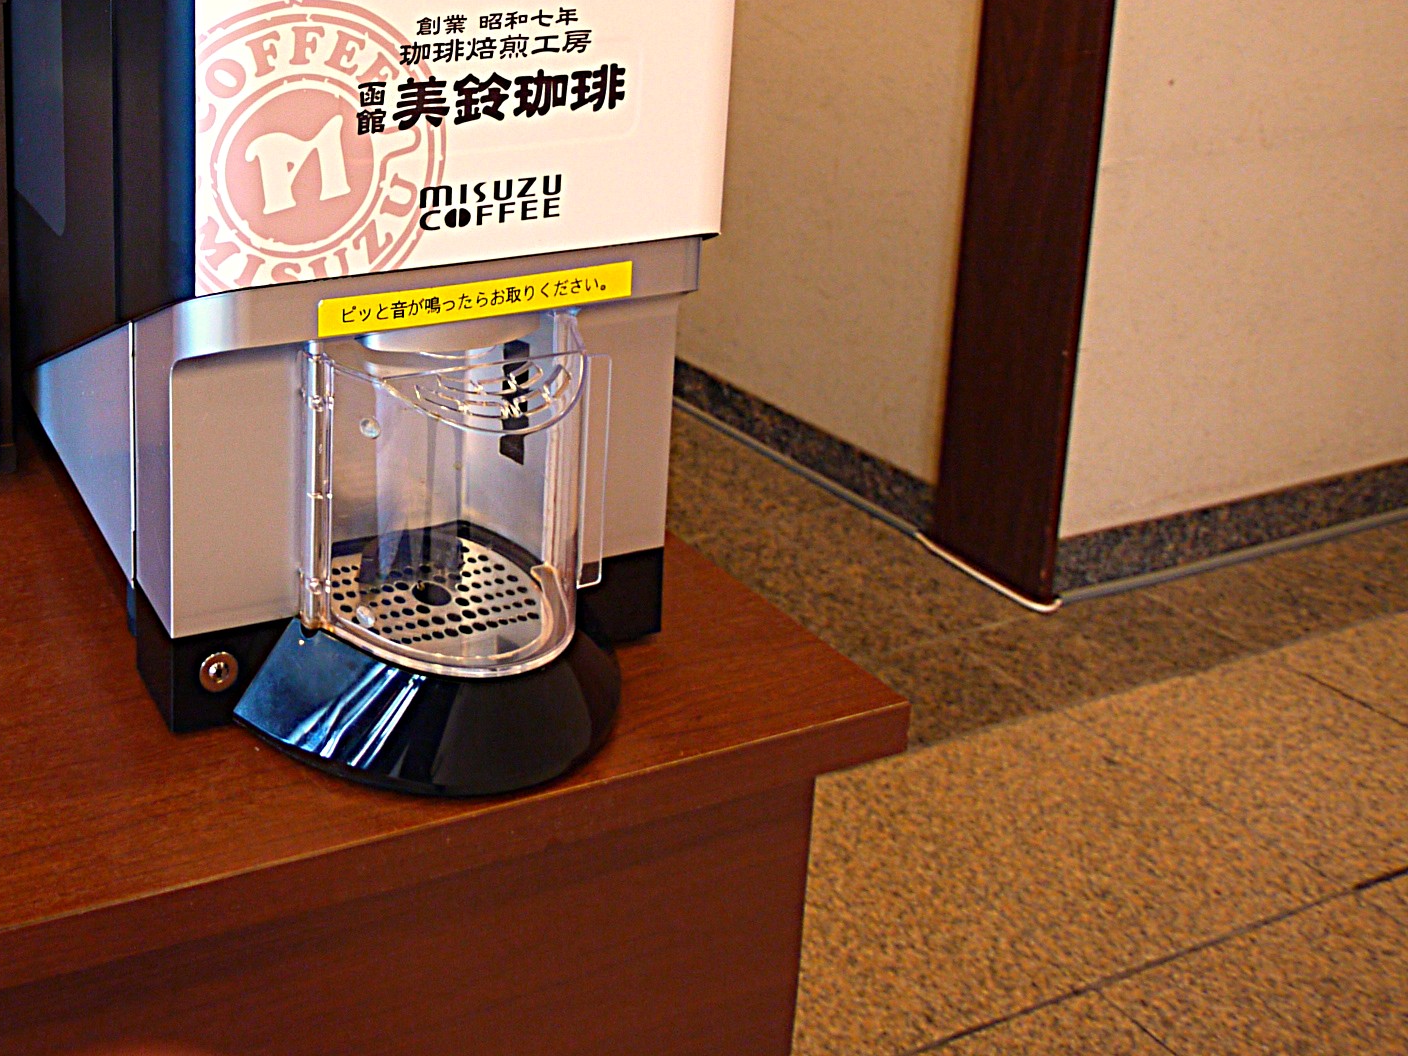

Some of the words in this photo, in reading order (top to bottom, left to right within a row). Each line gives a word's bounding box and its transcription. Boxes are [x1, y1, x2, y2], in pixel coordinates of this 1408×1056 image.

[416, 15, 468, 36] 創業
[479, 7, 579, 31] 昭和七年
[399, 29, 593, 65] 珈琲焙煎工房
[392, 63, 626, 131] 美鈴珈琲
[419, 174, 562, 209] MISUZU
[419, 197, 560, 231] COFFEE
[341, 277, 608, 323] ピッと音が鳴ったらお取りください。
